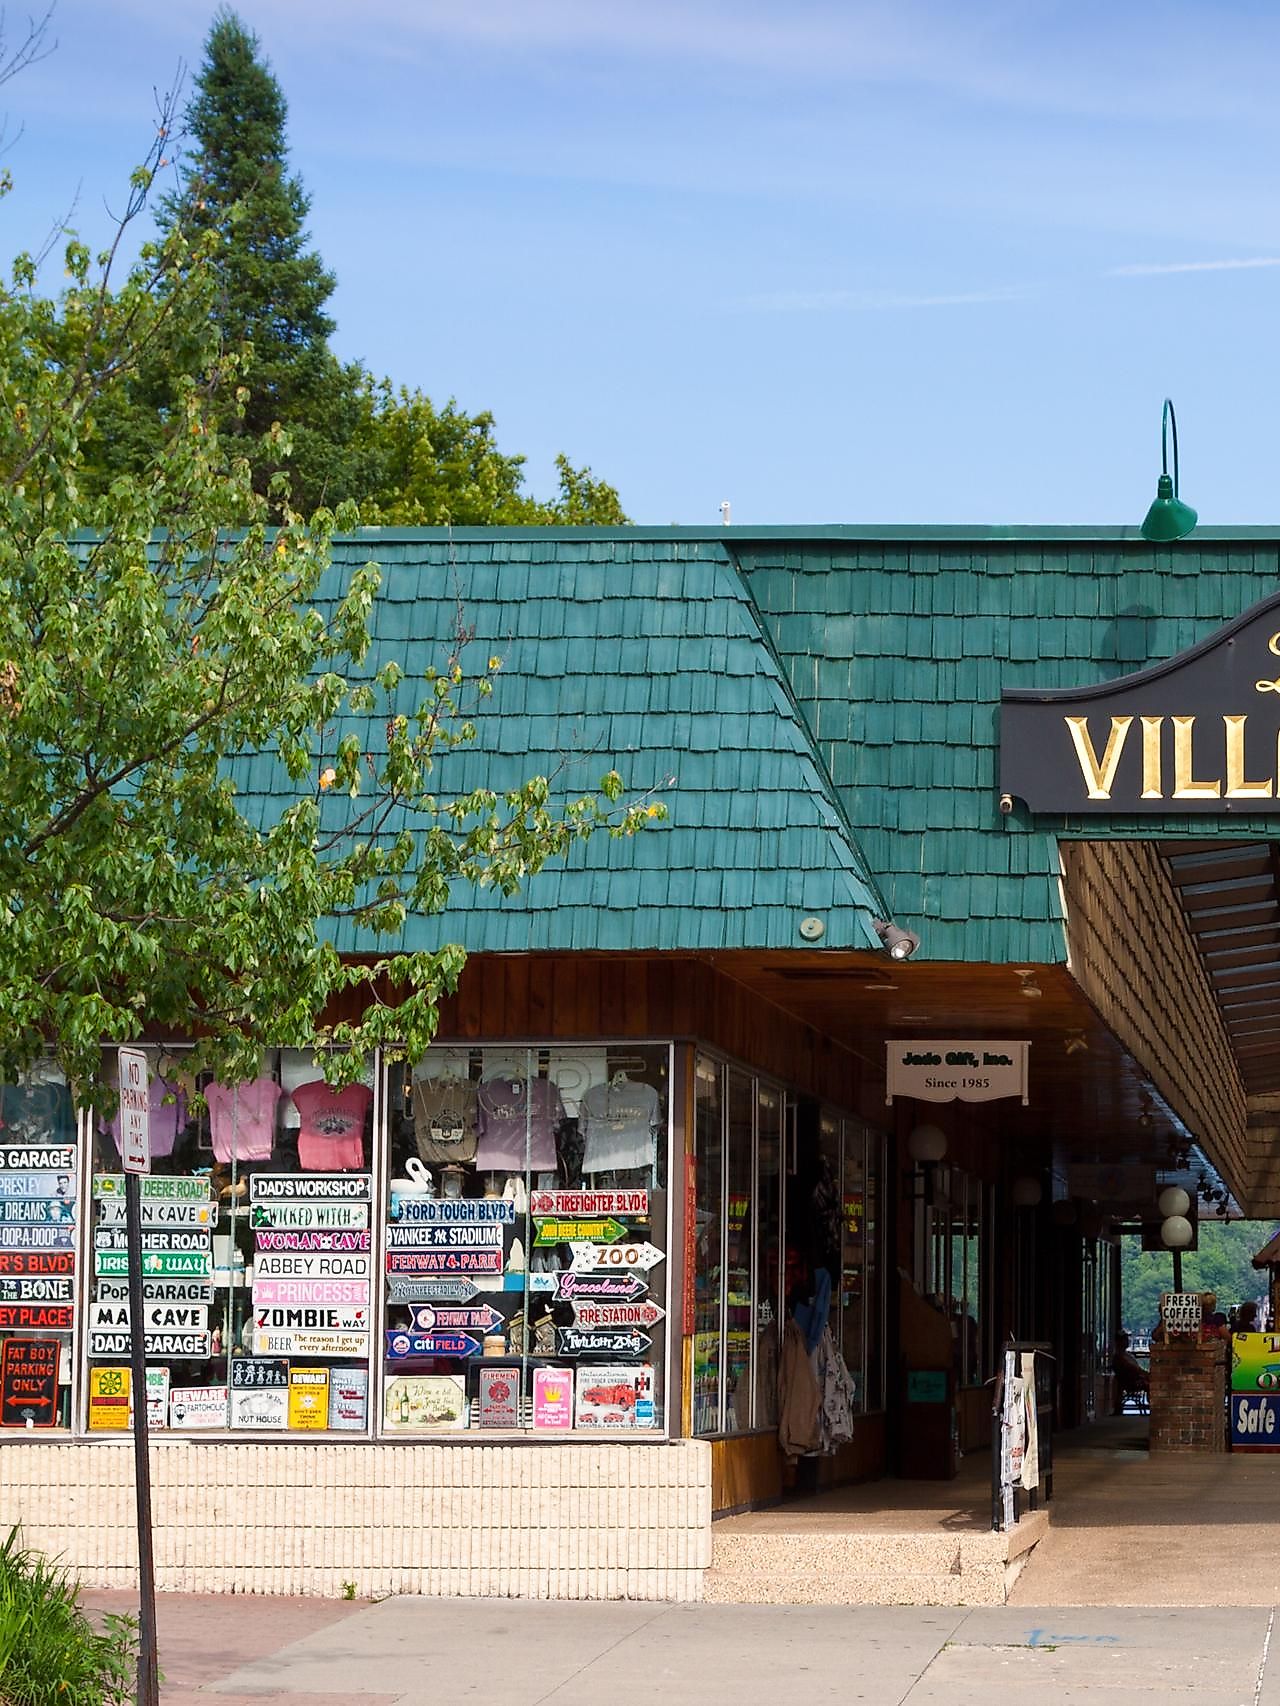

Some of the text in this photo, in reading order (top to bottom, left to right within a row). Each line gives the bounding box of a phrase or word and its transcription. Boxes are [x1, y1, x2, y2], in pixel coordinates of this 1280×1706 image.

[902, 1051, 1013, 1068] Jade Gift, Inc.
[128, 1062, 140, 1085] NO
[925, 1077, 989, 1089] Since 1985
[123, 1088, 148, 1112] PARKING
[131, 1115, 142, 1129] ANY
[130, 1132, 143, 1148] TIME
[8, 1151, 70, 1168] GARAGE
[145, 1181, 174, 1198] DEERE
[177, 1180, 203, 1197] ROAD
[259, 1181, 364, 1196] DAD'S WORKSHOP
[5, 1202, 46, 1221] DREAMS
[115, 1207, 196, 1221] MN CAVE
[269, 1208, 312, 1225] WICKED
[317, 1208, 351, 1225] WITCH
[406, 1204, 507, 1220] FORD TOUGH BLVD
[172, 1233, 208, 1249] ROAD
[257, 1232, 370, 1249] WOMAN CAVE
[392, 1228, 432, 1245] YANKEE
[450, 1228, 497, 1245] STADIUM
[0, 1256, 68, 1272] R'S BLVD
[103, 1257, 129, 1270] IRIS
[392, 1254, 498, 1270] FENWAY PARK
[597, 1248, 638, 1265] ZOO
[259, 1258, 366, 1275] ABBEY ROAD
[20, 1280, 70, 1299] BONE
[144, 1285, 209, 1300] GARAGE
[277, 1284, 352, 1302] PRINCESS
[1166, 1295, 1198, 1307] FRESH
[0, 1309, 67, 1325] EY PLACE
[98, 1308, 200, 1326] MA CAVE
[258, 1309, 366, 1328] ZOMBIE WAY
[579, 1307, 641, 1323] FIRE STATION
[1162, 1308, 1201, 1319] COFFEE
[95, 1335, 204, 1353] DAD' GARAGE
[267, 1337, 292, 1351] BEER
[294, 1334, 308, 1343] The
[310, 1335, 334, 1343] reason
[342, 1336, 353, 1346] get
[356, 1336, 365, 1345] up
[299, 1344, 357, 1353] every afternoon
[436, 1340, 466, 1351] FIELD
[8, 1347, 54, 1361] FAT BOY
[7, 1363, 54, 1376] PARKING
[483, 1372, 516, 1381] FIREMEN
[12, 1380, 47, 1391] ONLY
[293, 1373, 326, 1384] BEWARE
[173, 1390, 226, 1402] BEWARE
[239, 1415, 282, 1424] NUT HOUSE
[1237, 1397, 1275, 1435] Safe
